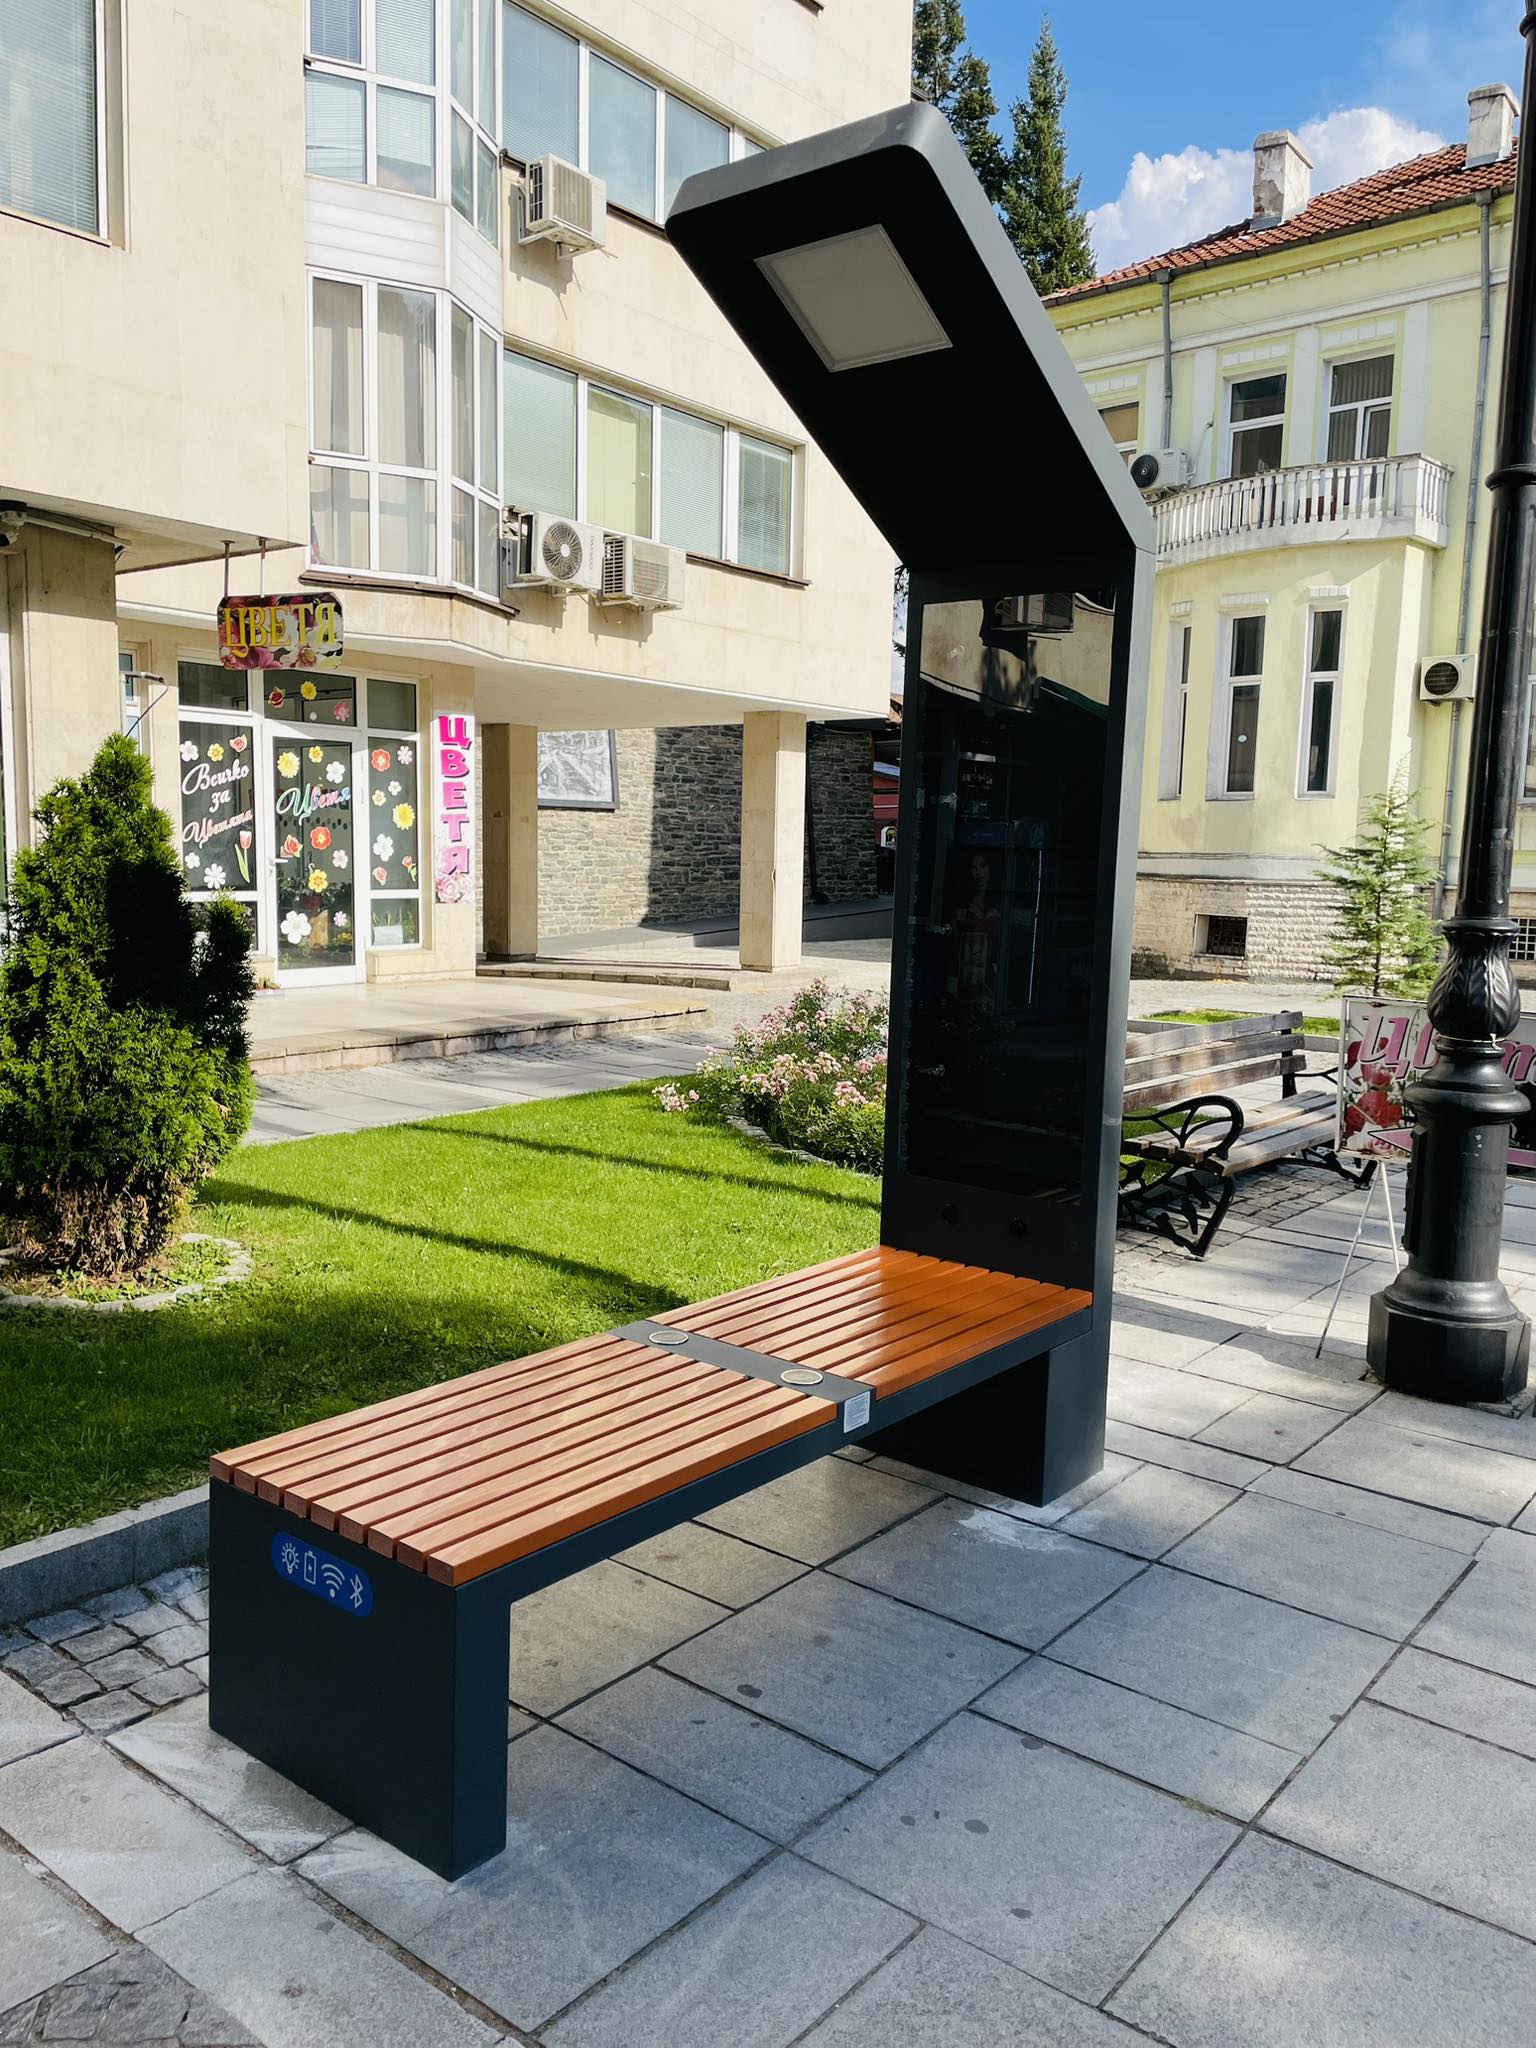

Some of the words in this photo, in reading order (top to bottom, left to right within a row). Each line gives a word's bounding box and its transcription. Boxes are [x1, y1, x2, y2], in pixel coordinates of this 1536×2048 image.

[223, 602, 336, 658] ЦВЕТЯ
[182, 759, 249, 795] Всичко
[439, 716, 472, 875] ЦВЕТЯ
[209, 790, 231, 813] за
[276, 783, 351, 826] Цветя
